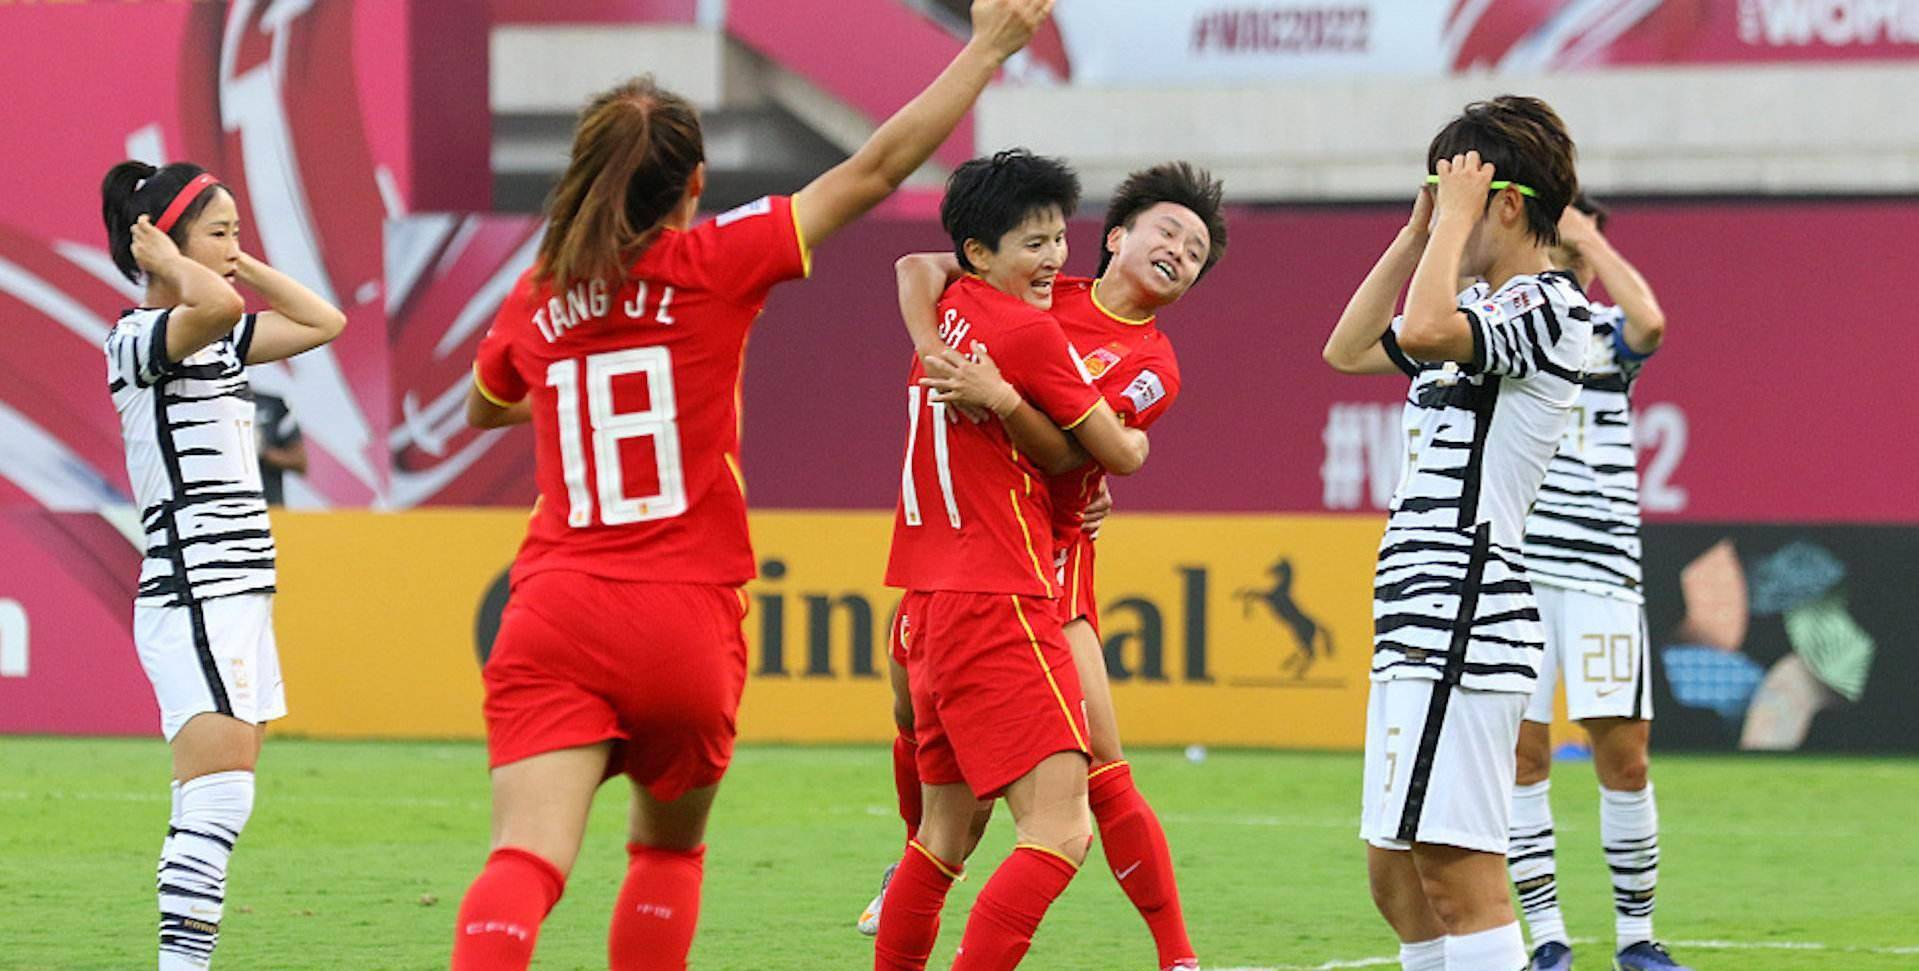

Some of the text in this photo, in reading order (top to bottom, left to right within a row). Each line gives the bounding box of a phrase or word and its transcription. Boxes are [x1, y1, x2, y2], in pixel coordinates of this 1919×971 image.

[1193, 10, 1369, 51] #WAC2022
[532, 278, 608, 343] TANG
[623, 280, 648, 319] J
[545, 345, 688, 528] 18
[902, 384, 961, 530] 11
[1582, 633, 1633, 682] 20
